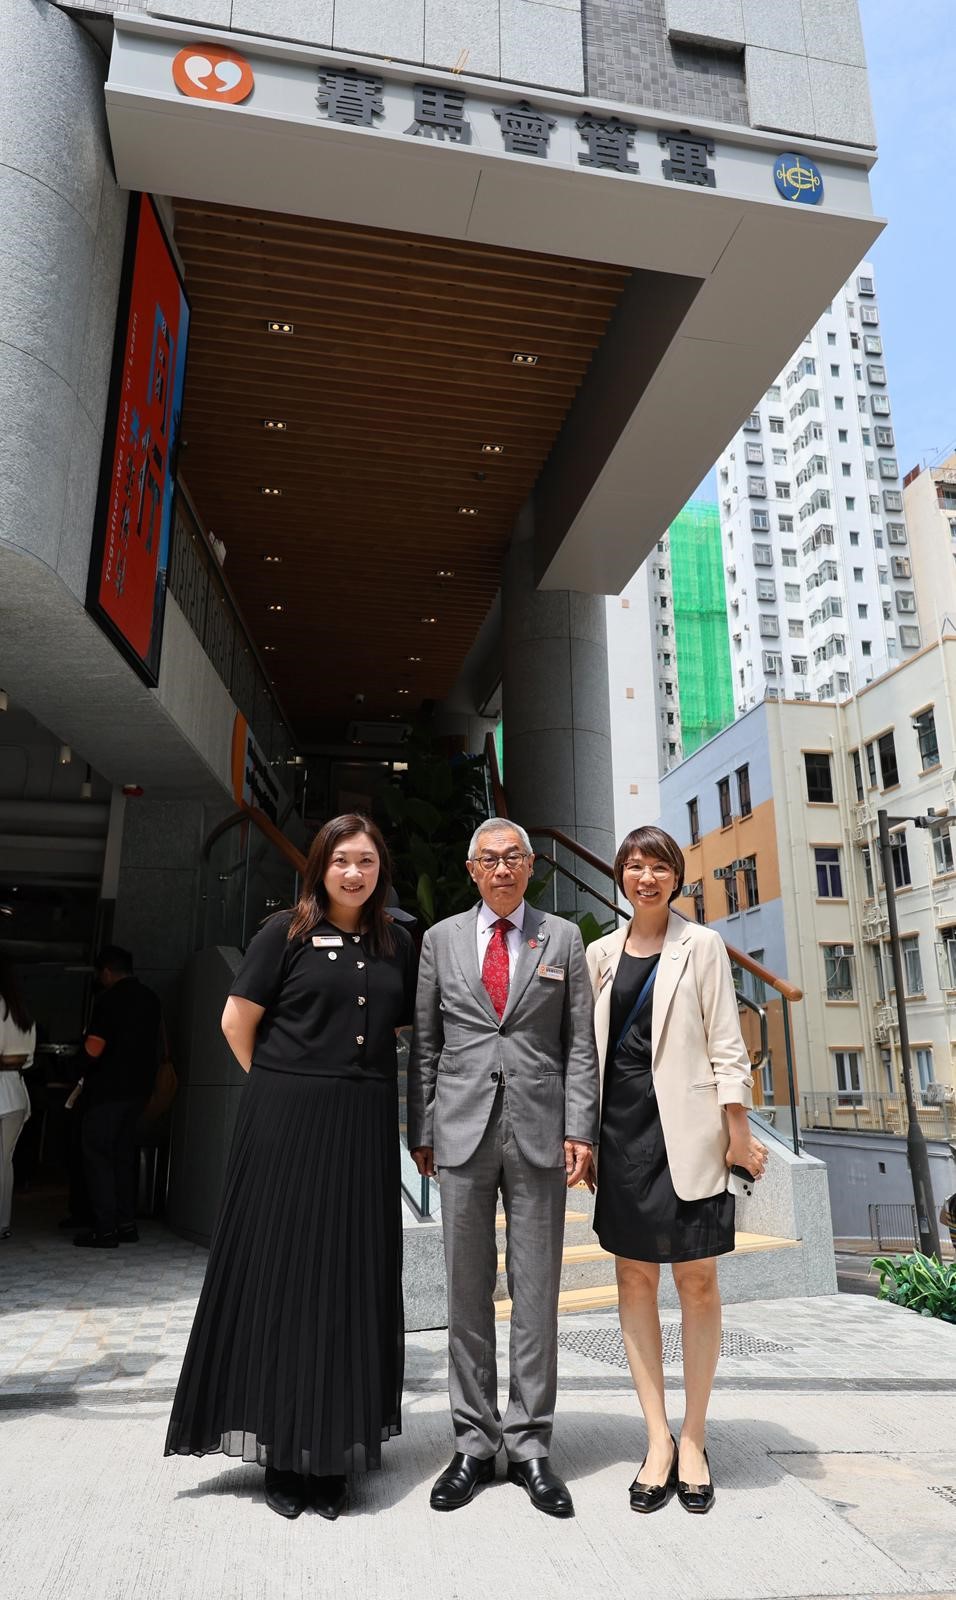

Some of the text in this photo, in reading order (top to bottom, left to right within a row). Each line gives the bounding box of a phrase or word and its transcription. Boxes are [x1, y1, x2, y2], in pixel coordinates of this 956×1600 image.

[315, 66, 717, 188] 賽馬會箕寓
